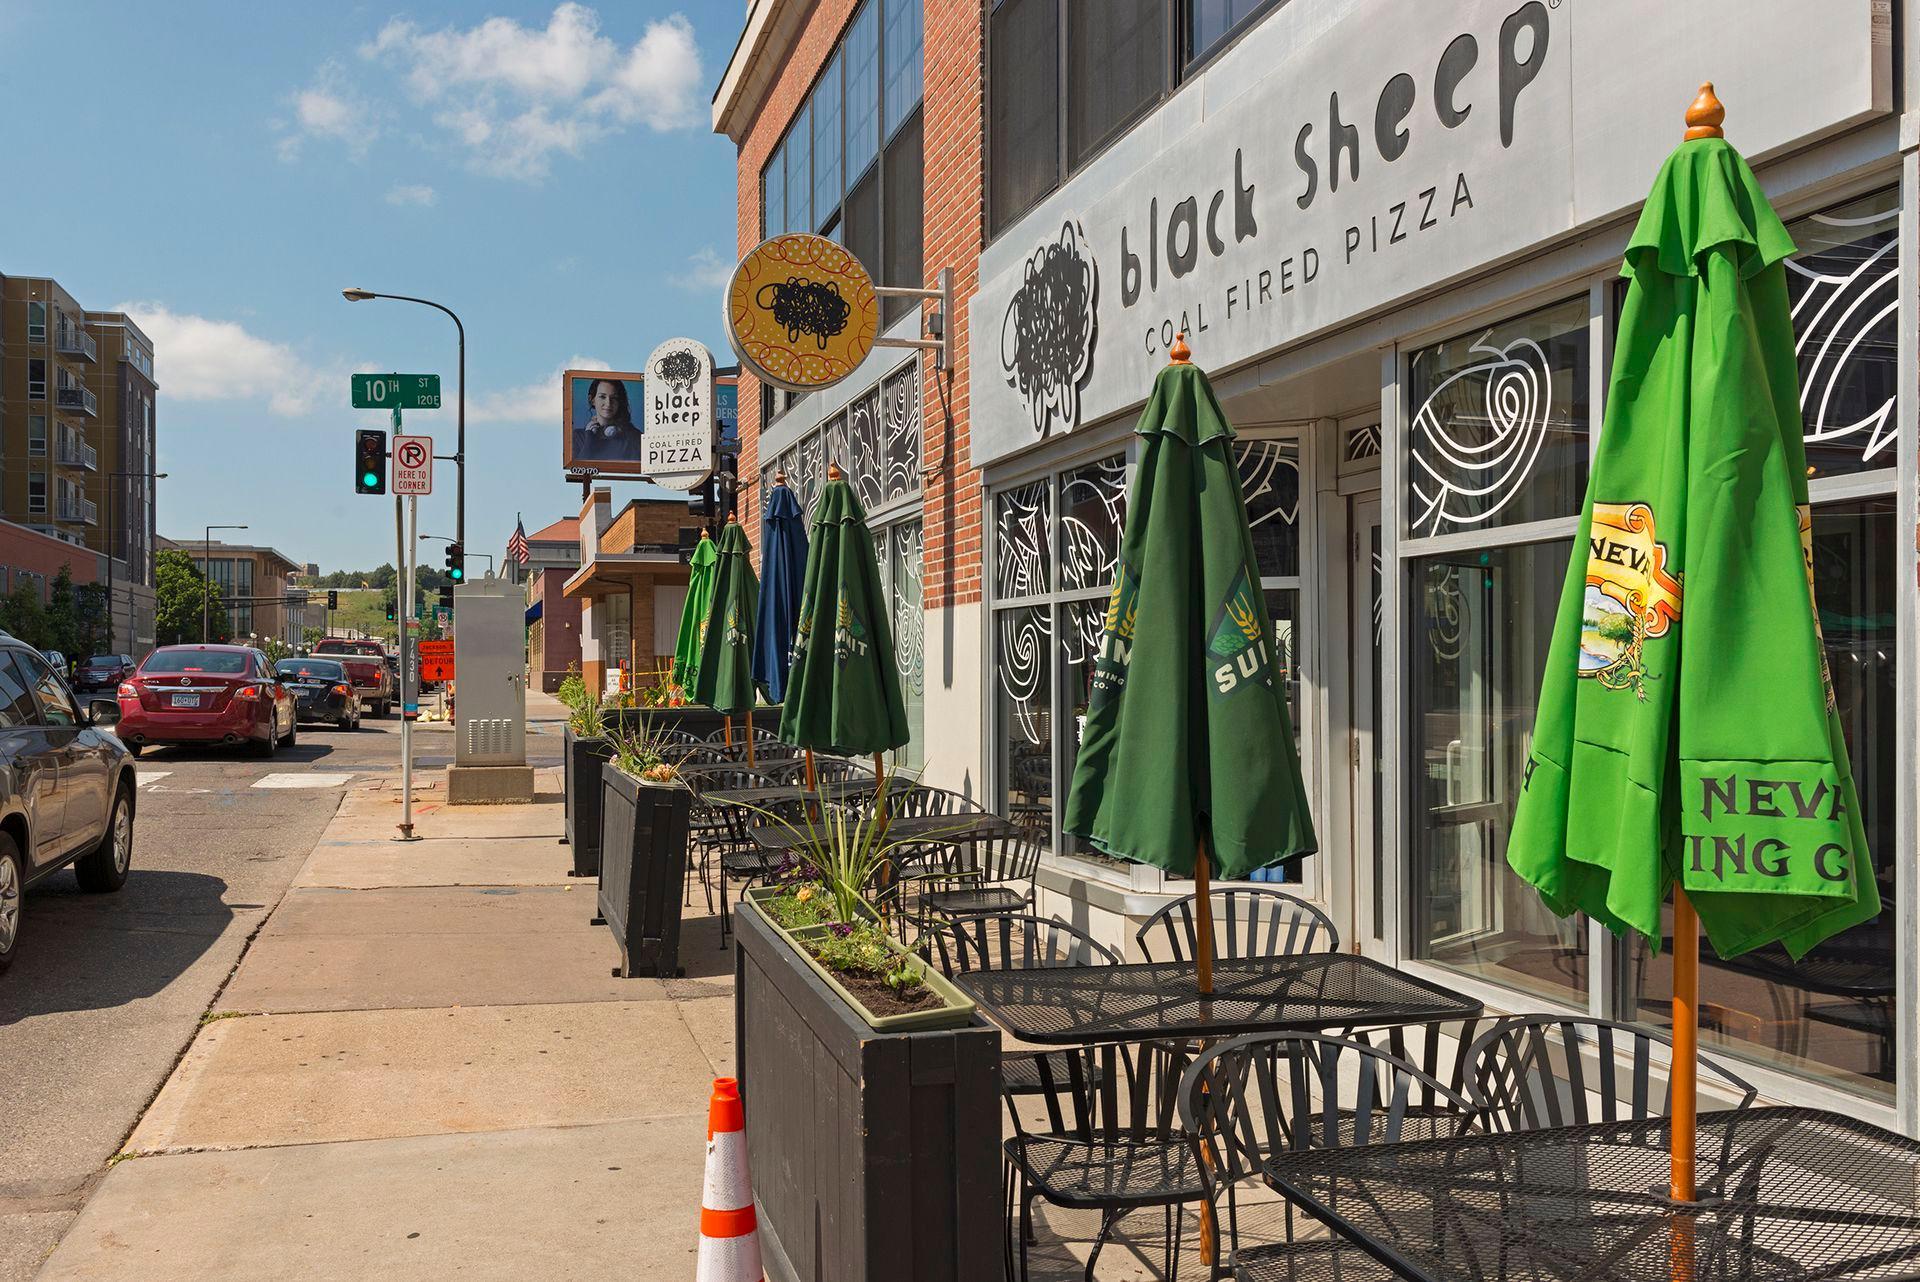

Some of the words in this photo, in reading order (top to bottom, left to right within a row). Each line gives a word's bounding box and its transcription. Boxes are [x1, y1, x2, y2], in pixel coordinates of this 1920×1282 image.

[1121, 148, 1258, 309] black
[1294, 0, 1550, 210] sheep
[1145, 303, 1209, 356] COAL
[1227, 247, 1320, 320] FIRED
[1345, 172, 1474, 265] PIZZA
[418, 377, 429, 388] ST
[417, 395, 440, 406] 120E
[655, 391, 700, 411] black
[655, 411, 700, 427] sheep
[650, 441, 672, 449] COAL
[676, 438, 703, 447] FIRED
[650, 447, 702, 465] PIZZA
[398, 470, 416, 479] HERE
[418, 470, 426, 480] TO
[398, 481, 426, 490] CORNER
[1681, 832, 1792, 883] ING
